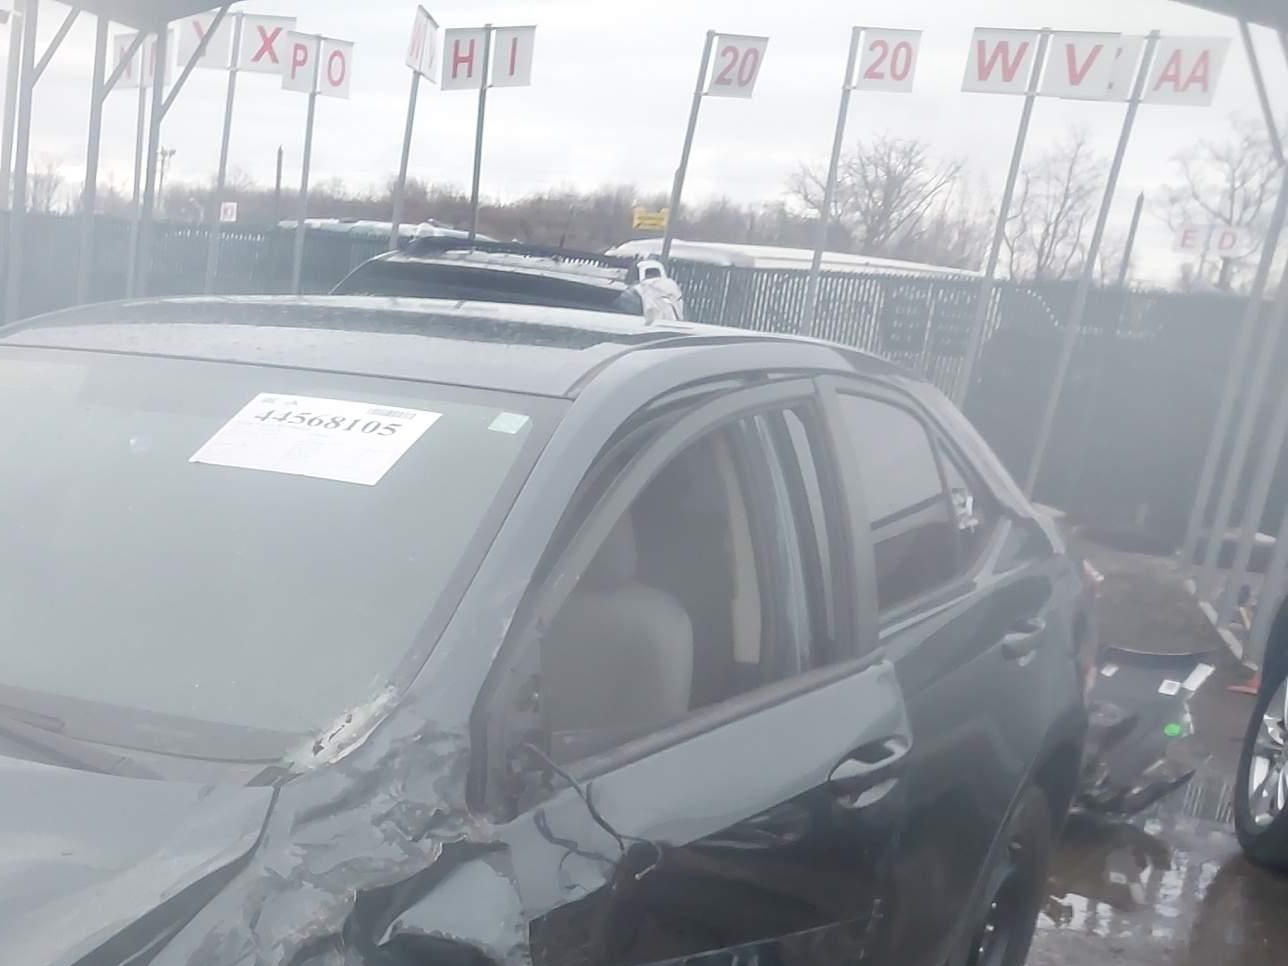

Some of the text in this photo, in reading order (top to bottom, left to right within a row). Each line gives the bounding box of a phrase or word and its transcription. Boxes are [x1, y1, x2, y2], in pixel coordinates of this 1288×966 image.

[252, 25, 284, 64] X
[290, 43, 347, 88] P O
[451, 38, 476, 80] H
[508, 36, 518, 77] I
[863, 39, 914, 82] 20
[976, 40, 1030, 83] W
[1065, 43, 1104, 86] V
[715, 45, 760, 88] 20
[1153, 48, 1211, 93] AA
[1180, 229, 1199, 249] E
[254, 408, 404, 438] 44568105
